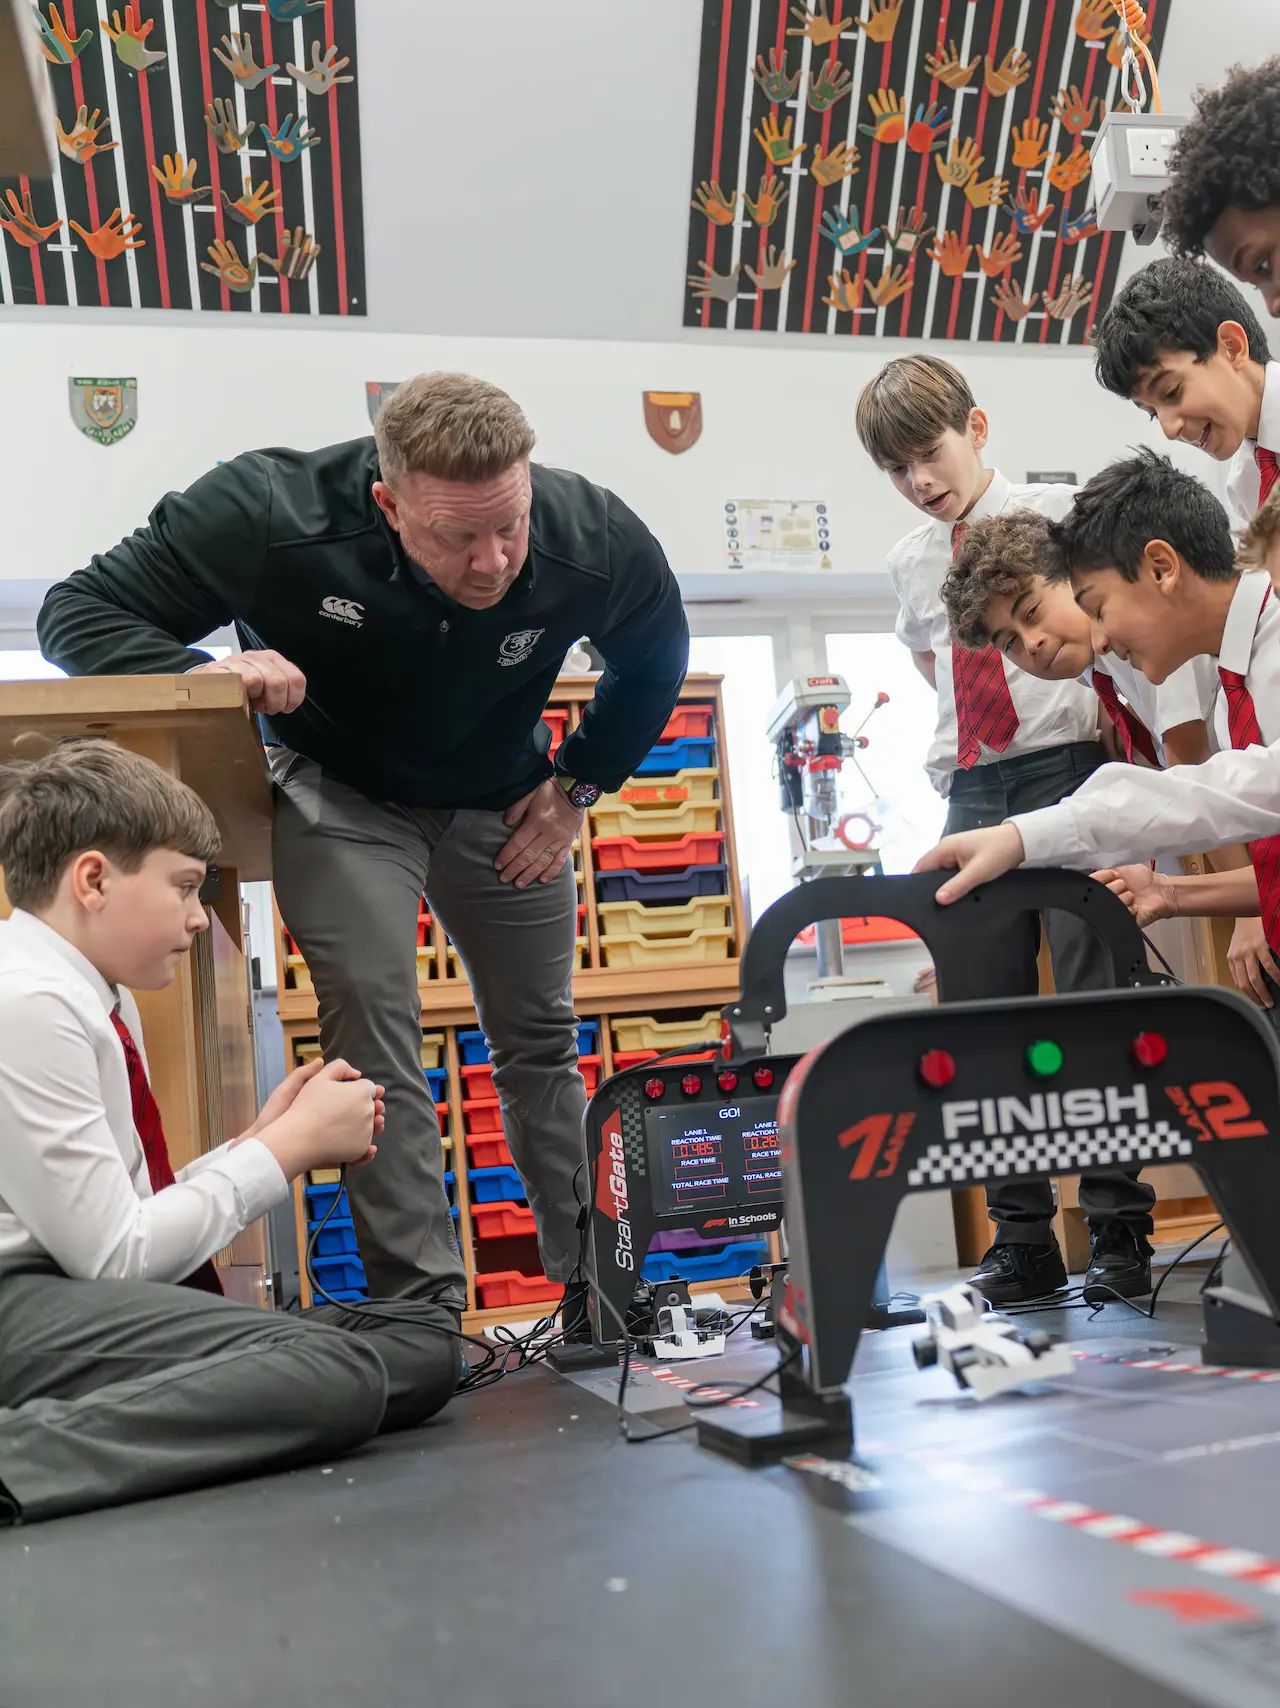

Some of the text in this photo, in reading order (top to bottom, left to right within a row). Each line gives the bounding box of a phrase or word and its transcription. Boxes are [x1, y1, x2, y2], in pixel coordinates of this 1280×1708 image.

[318, 610, 363, 628] canterbury
[719, 1108, 741, 1119] GO!
[942, 1084, 1149, 1140] FINISH
[1189, 1081, 1269, 1140] 2
[671, 1137, 704, 1146] REACTION
[742, 1130, 774, 1138] REACTION
[838, 1113, 893, 1180] 1
[694, 1179, 712, 1187] RACE
[610, 1131, 634, 1272] StartGate
[739, 1212, 777, 1224] Schools
